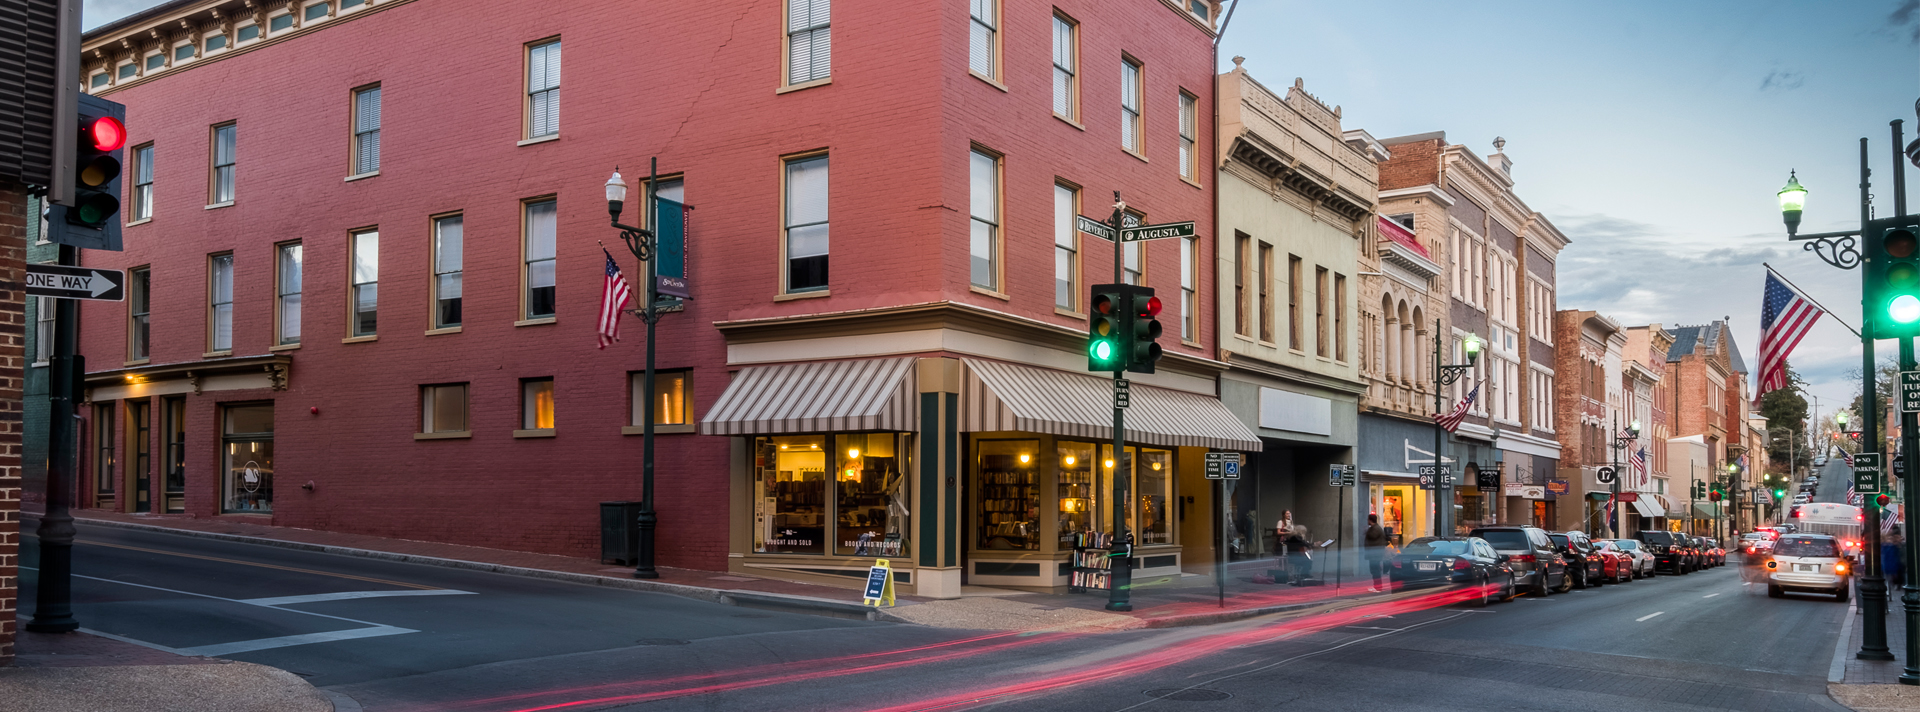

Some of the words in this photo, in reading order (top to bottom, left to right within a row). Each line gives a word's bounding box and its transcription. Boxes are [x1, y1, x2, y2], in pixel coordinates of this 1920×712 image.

[1084, 221, 1109, 239] BEVERLEY
[1137, 227, 1180, 240] AUGUSTA
[26, 273, 55, 287] ONE
[61, 276, 92, 290] WAY
[1420, 467, 1450, 475] DESN
[1600, 470, 1612, 480] 17
[876, 541, 900, 549] RECORDS
